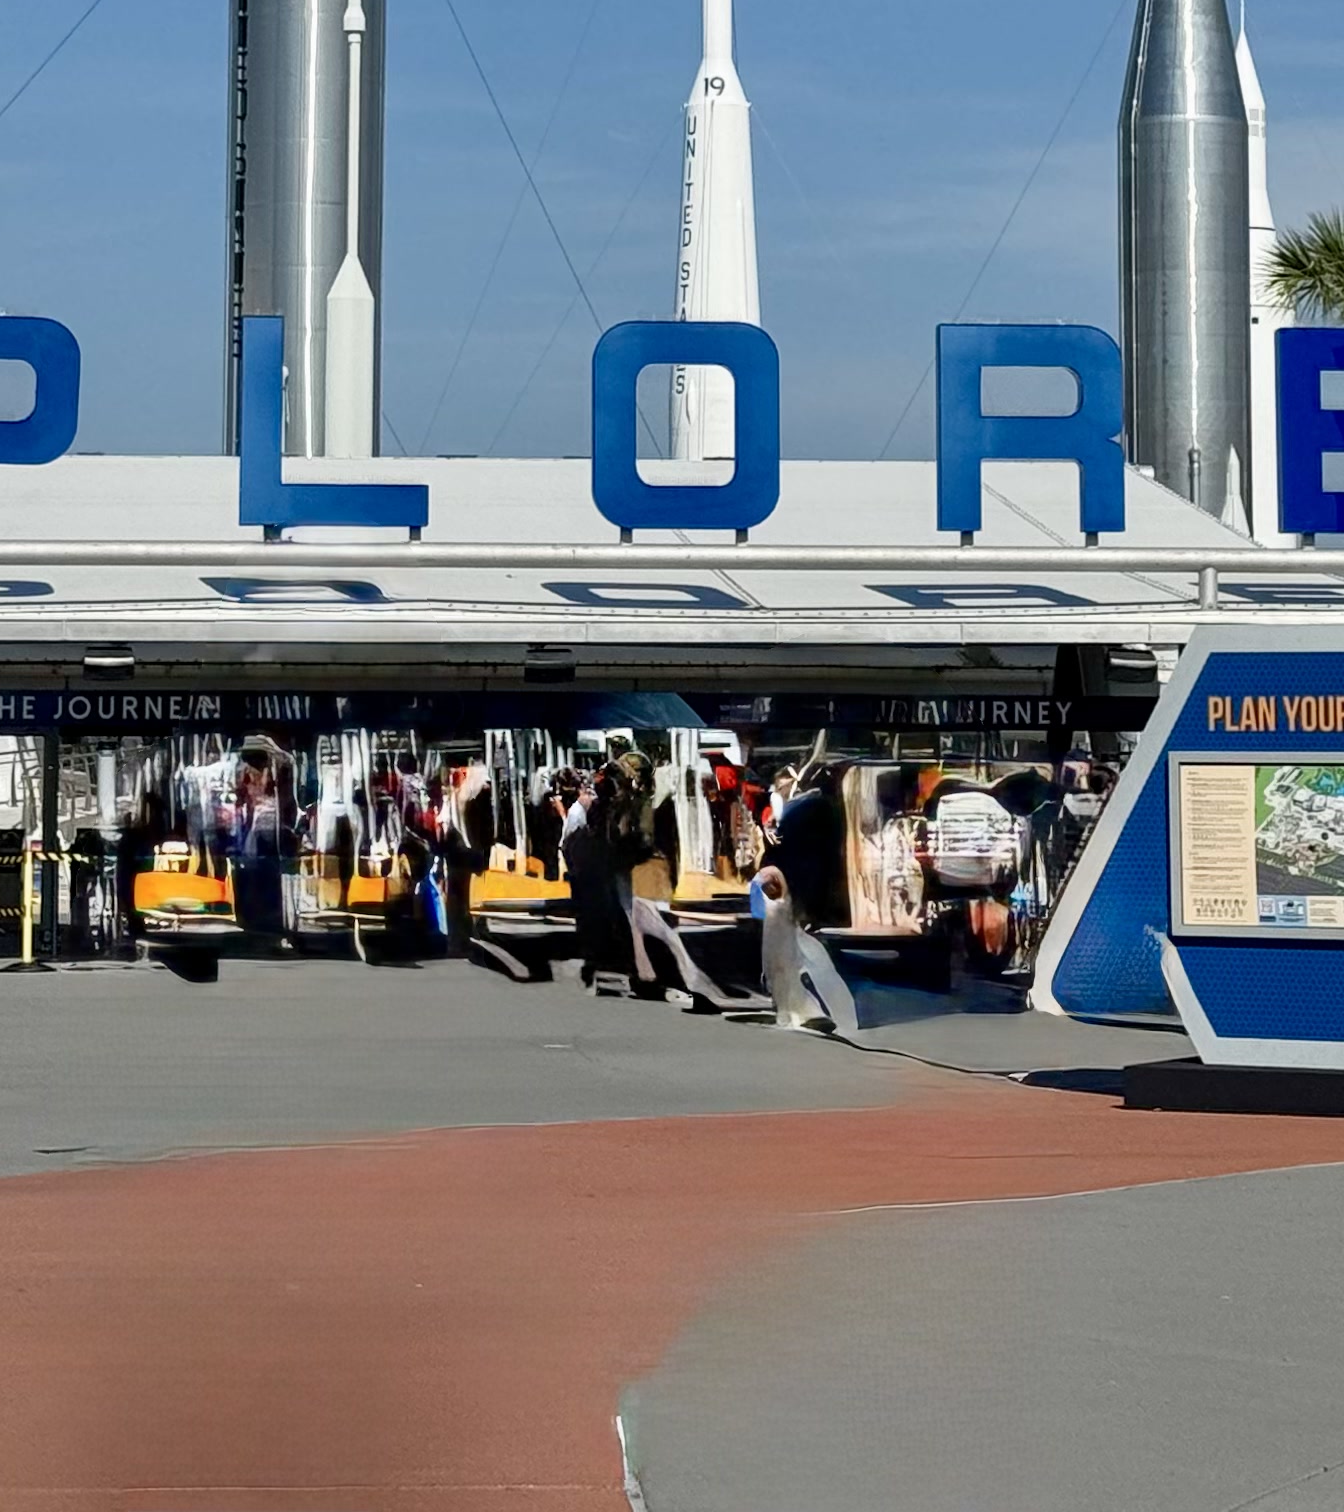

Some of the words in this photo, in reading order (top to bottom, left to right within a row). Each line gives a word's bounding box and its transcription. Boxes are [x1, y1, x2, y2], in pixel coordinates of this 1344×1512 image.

[704, 76, 725, 97] 19
[682, 115, 697, 248] UNITED
[1208, 695, 1276, 732] PLAN
